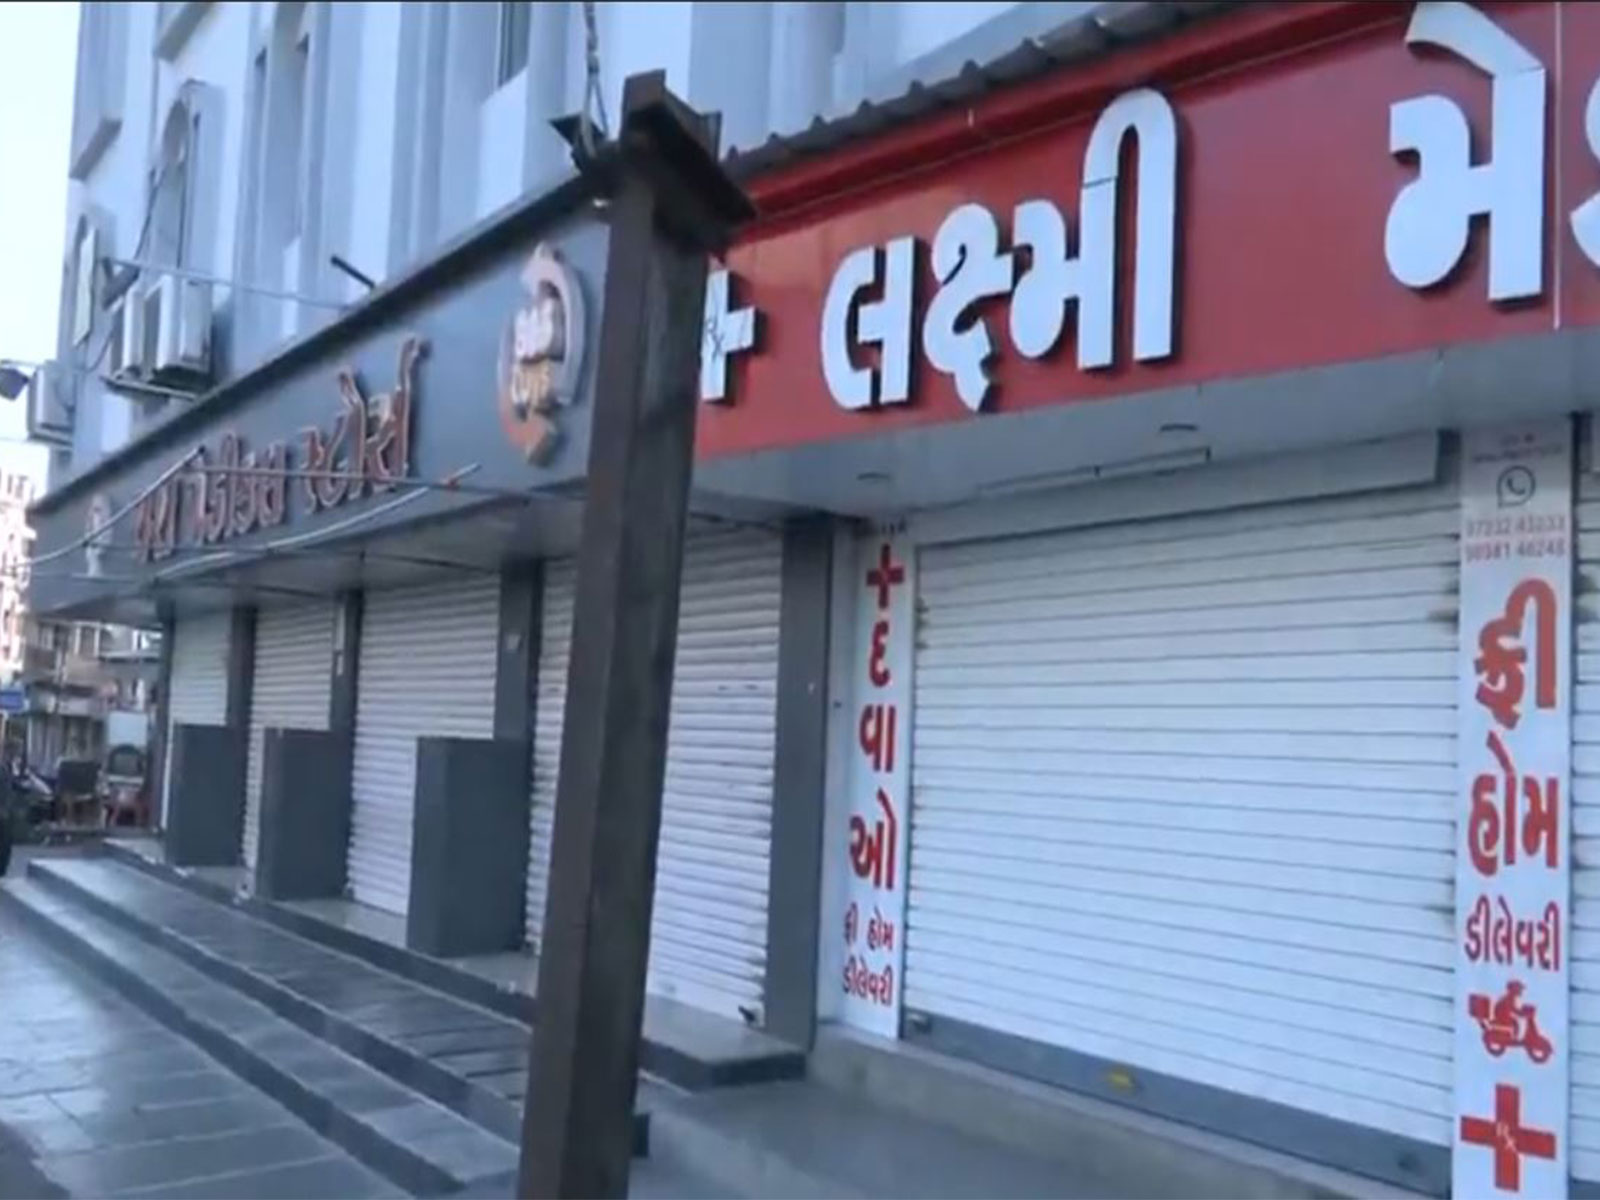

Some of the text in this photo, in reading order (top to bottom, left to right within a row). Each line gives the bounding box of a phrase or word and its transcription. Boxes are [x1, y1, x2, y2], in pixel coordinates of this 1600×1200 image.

[820, 88, 1180, 412] લક્ષ્મી
[1468, 730, 1559, 876] હોમ
[1464, 894, 1561, 972] ડીલેવરી
